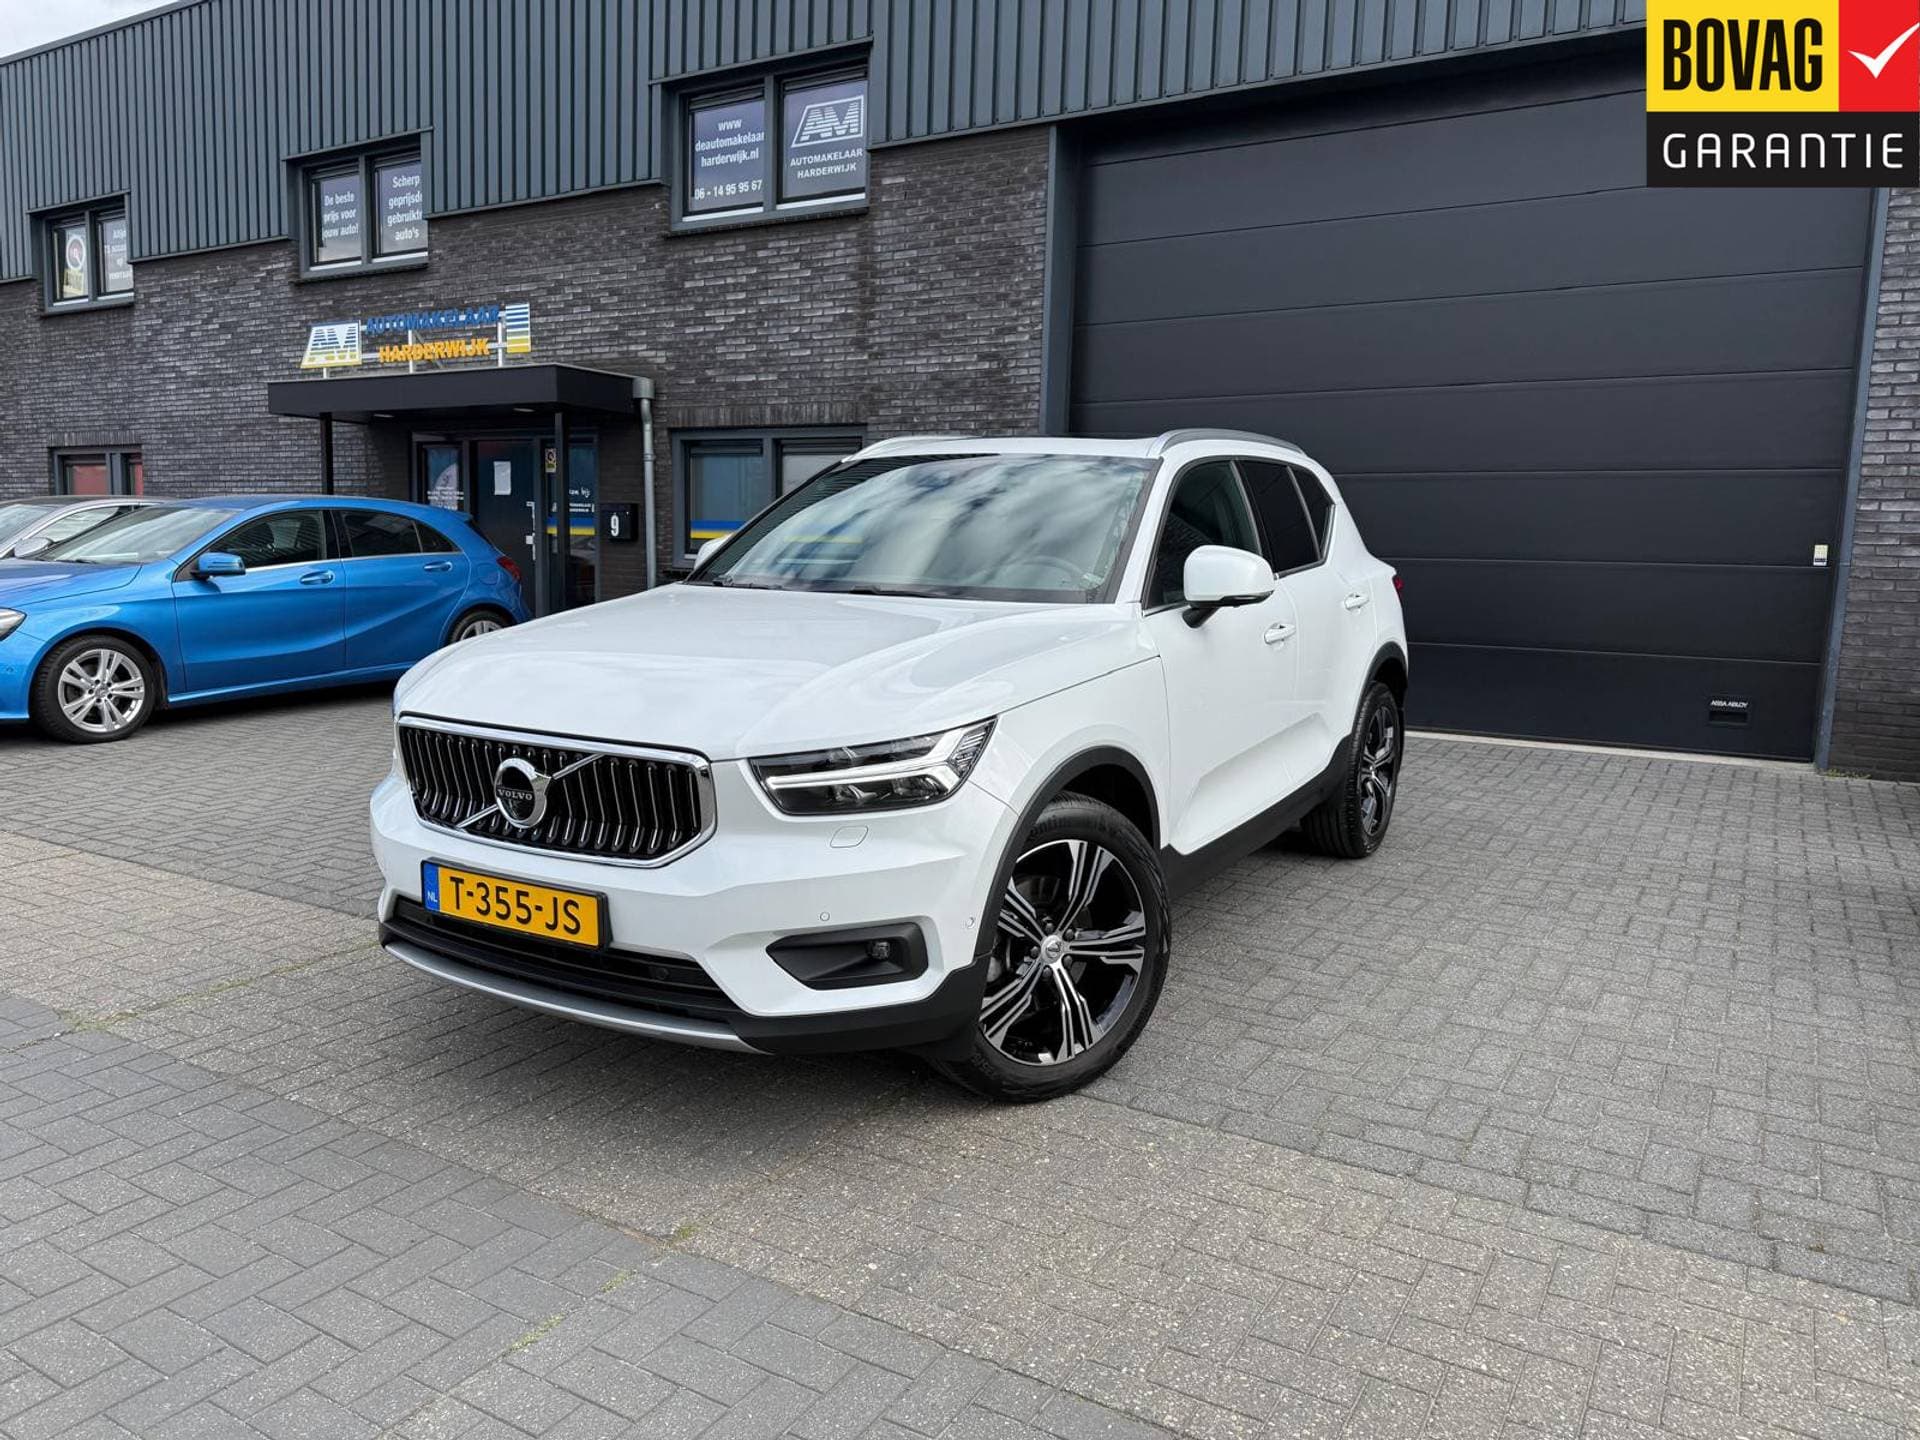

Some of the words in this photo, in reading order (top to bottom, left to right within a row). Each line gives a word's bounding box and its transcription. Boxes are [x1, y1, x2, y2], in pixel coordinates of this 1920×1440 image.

[718, 118, 743, 131] www
[799, 101, 859, 142] AM
[701, 148, 759, 168] harderwijk.nl
[790, 148, 864, 167] AUTOMAKELAAR
[797, 162, 857, 179] HARDERWIJK
[392, 174, 420, 188] Scherp
[694, 187, 705, 200] 06
[713, 185, 724, 197] 14
[726, 183, 737, 196] 95
[738, 181, 750, 194] 95
[751, 180, 763, 192] 67
[334, 191, 355, 205] beste
[323, 210, 339, 224] prijs
[340, 208, 357, 220] voor
[394, 227, 420, 241] auto's
[366, 305, 500, 335] AUTOMAKELAAR
[379, 337, 491, 364] HARDERWIJK
[610, 513, 620, 537] 9
[497, 788, 533, 801] VOLVO
[427, 890, 438, 903] NL
[449, 876, 581, 935] T-355-JS
